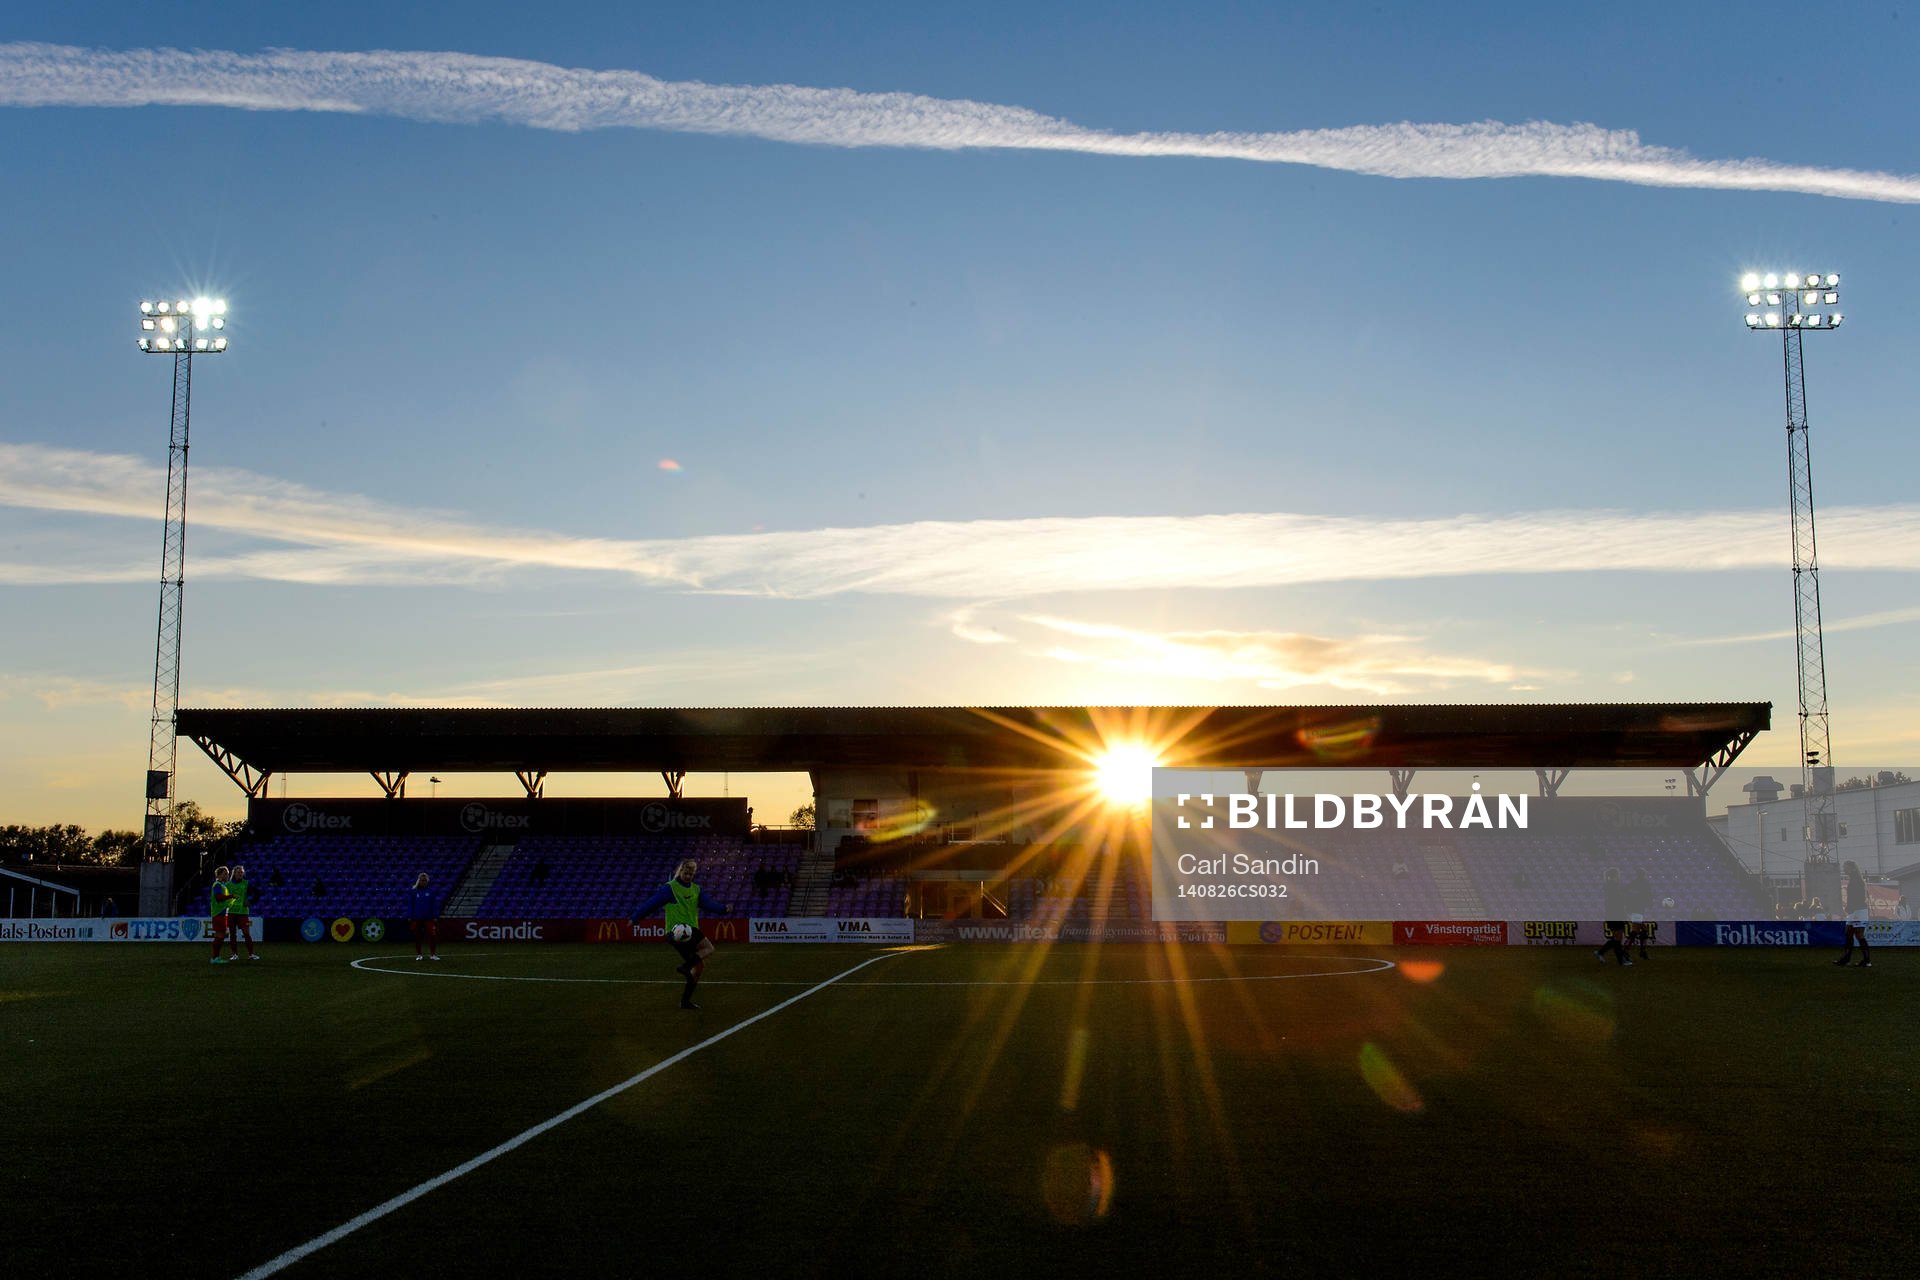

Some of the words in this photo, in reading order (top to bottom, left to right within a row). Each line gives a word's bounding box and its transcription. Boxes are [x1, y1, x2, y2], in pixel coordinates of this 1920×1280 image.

[301, 809, 352, 828] Jitex
[480, 809, 530, 828] Jitex
[662, 809, 711, 828] Jitex
[0, 922, 76, 939] als-Posten
[131, 921, 180, 939] TIPS
[465, 921, 543, 940] Scandic
[755, 922, 788, 932] VMA
[838, 921, 871, 932] VMA
[1288, 924, 1364, 941] POSTEN!
[1425, 922, 1502, 937] Vänsterpartiet
[1524, 921, 1577, 939] SPORT
[1715, 924, 1809, 945] Folksam
